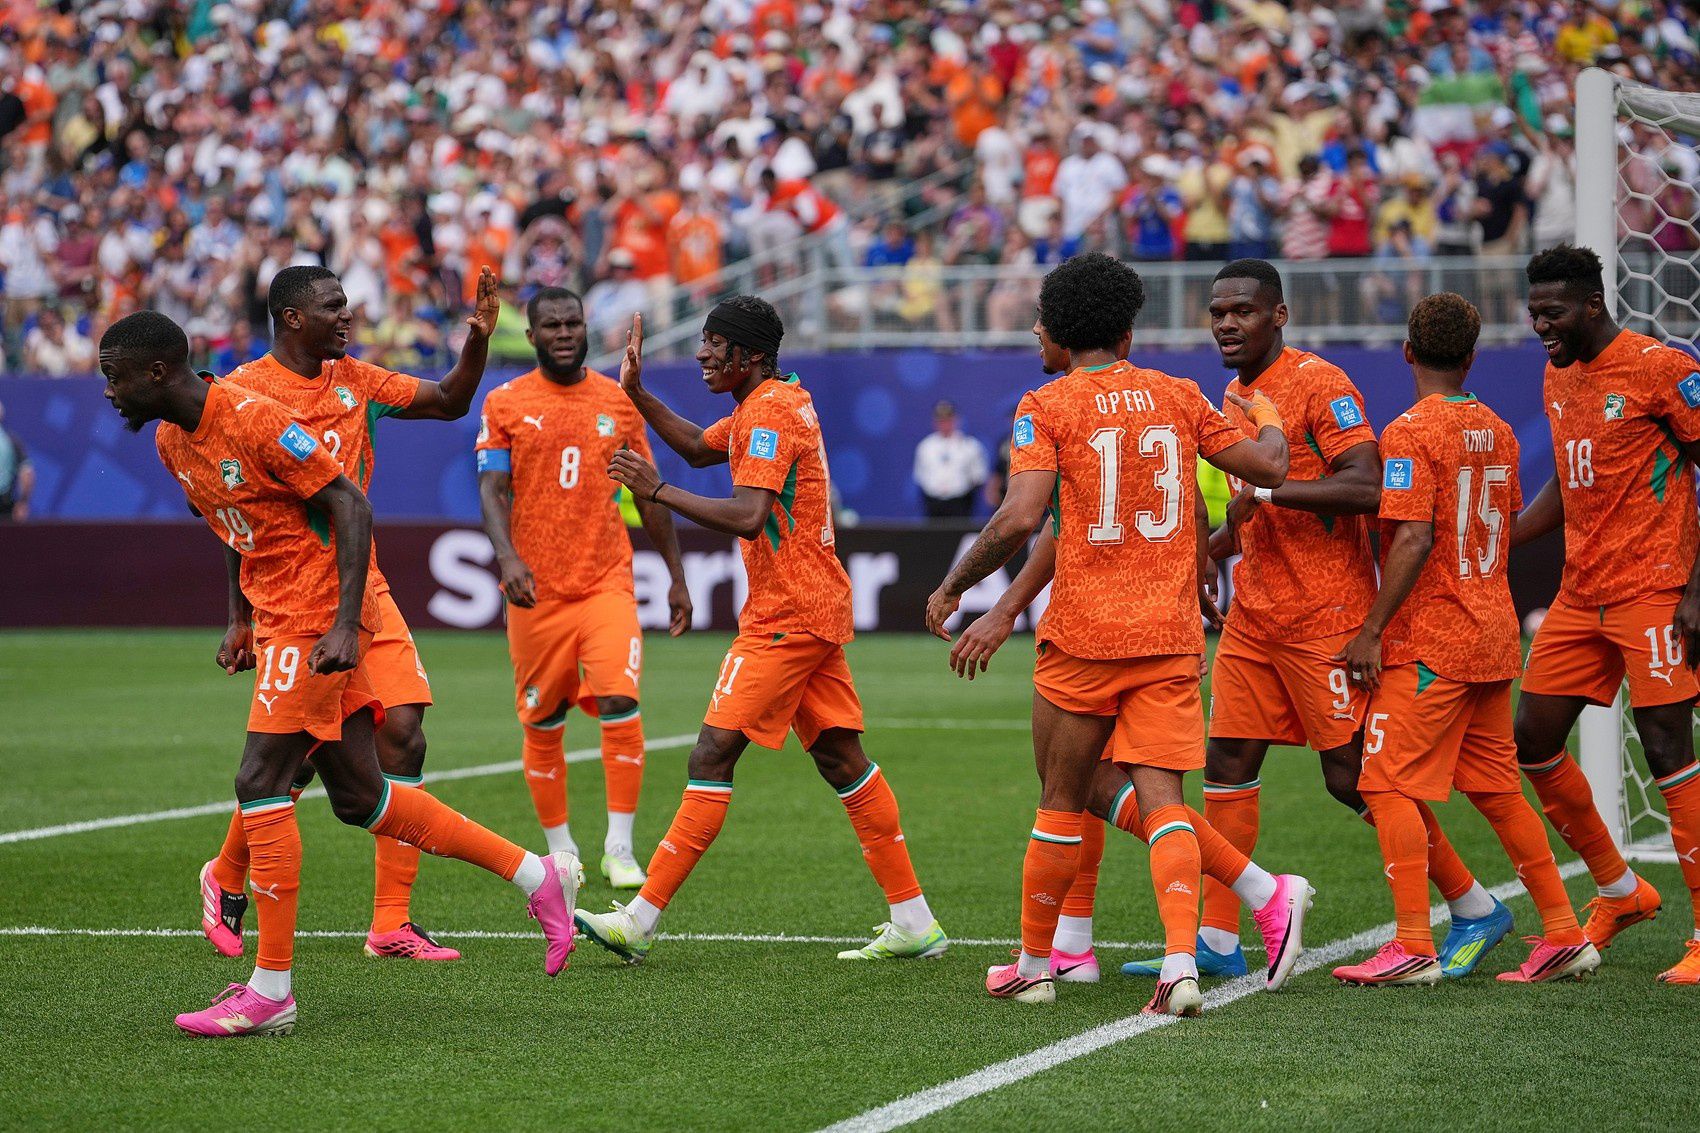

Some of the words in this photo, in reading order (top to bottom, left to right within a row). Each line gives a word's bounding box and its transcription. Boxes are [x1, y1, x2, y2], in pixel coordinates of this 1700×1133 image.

[1094, 389, 1156, 414] OPERI
[559, 446, 581, 489] 8
[1087, 424, 1185, 546] 13
[1565, 438, 1595, 489] 18
[216, 507, 256, 552] 19
[1457, 465, 1512, 579] 15
[259, 645, 300, 691] 19
[627, 636, 642, 671] 8
[714, 652, 745, 696] 11
[1327, 668, 1351, 710] 9
